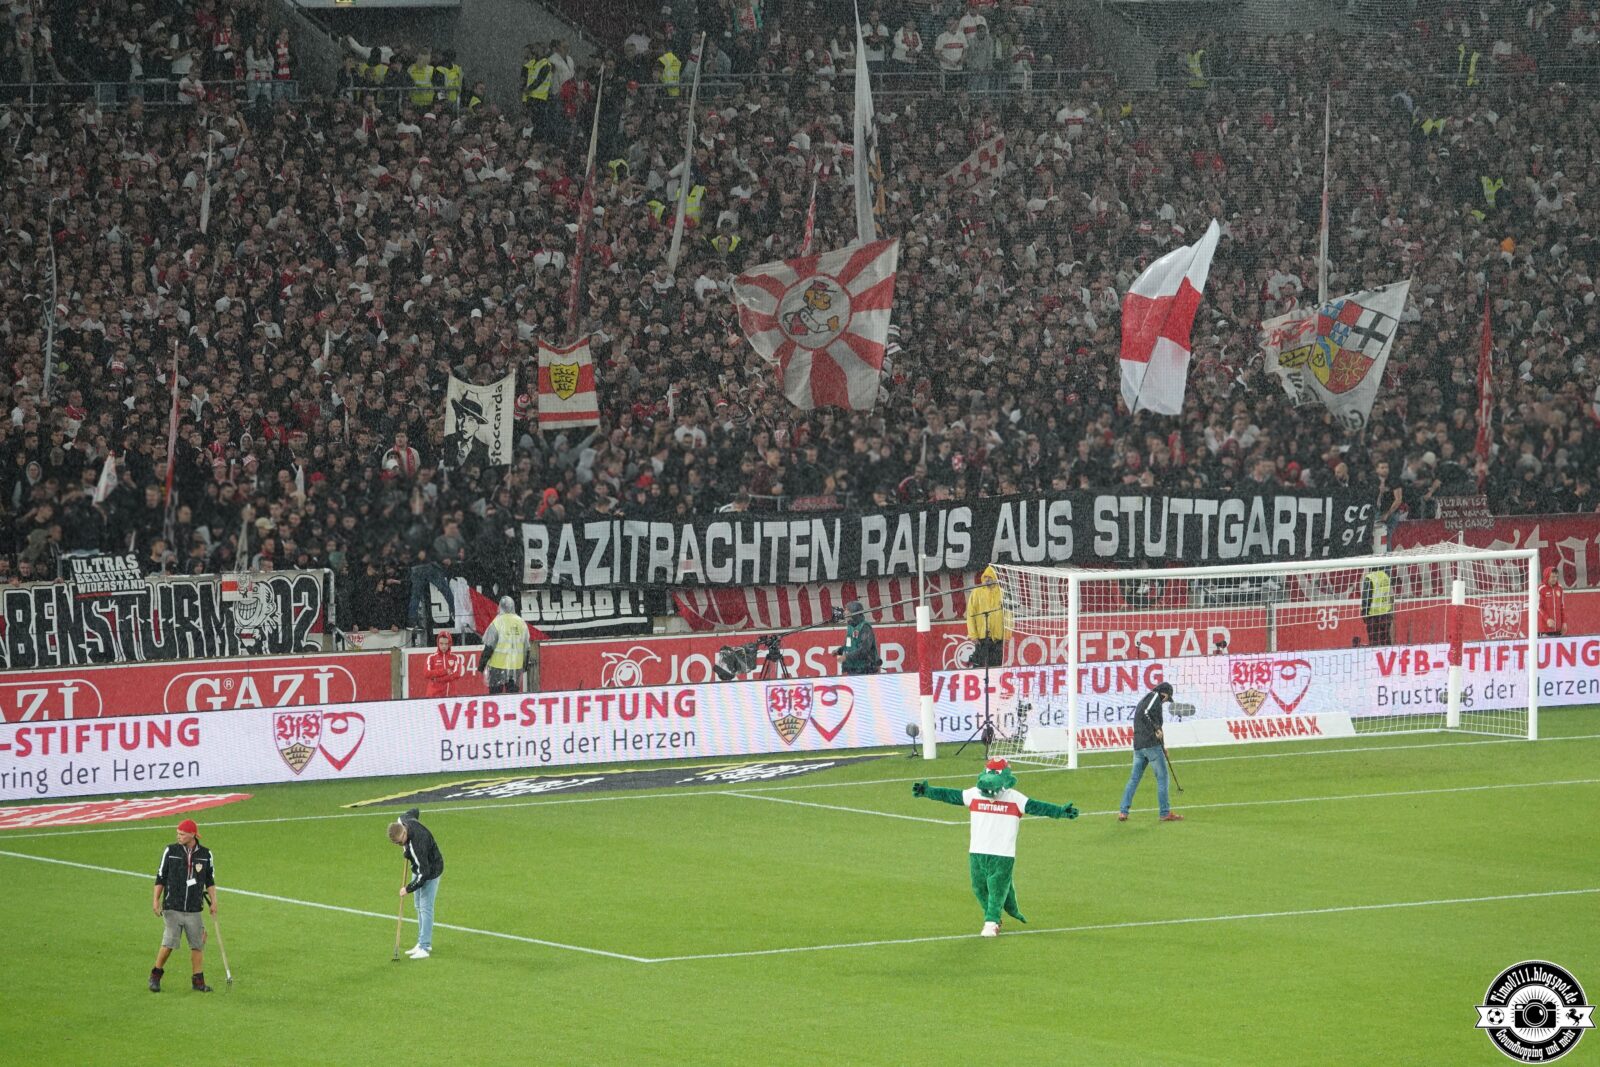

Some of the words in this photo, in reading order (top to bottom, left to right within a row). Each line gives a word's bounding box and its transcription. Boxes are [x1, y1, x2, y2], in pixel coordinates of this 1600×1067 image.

[491, 384, 504, 466] Stoccarda
[1344, 503, 1371, 523] CC
[521, 518, 841, 586] BAZITRACHTEN
[860, 506, 973, 577] RAUS
[990, 499, 1074, 564] AUS
[1094, 495, 1334, 560] STUTTGART!
[1341, 525, 1367, 546] 97
[71, 554, 139, 574] ULTRAS
[75, 569, 142, 584] BEDEUTET
[77, 579, 146, 594] WIDERSTAND
[1317, 608, 1338, 631] 35
[1376, 640, 1600, 677] VfB-TIFTUNG
[1484, 679, 1517, 700] der
[438, 689, 697, 731] VfB-STIFTUNG
[1039, 703, 1066, 726] de
[1086, 702, 1137, 723] Herz
[1226, 716, 1324, 740] WINAMAX
[441, 736, 552, 762] Brustring
[563, 732, 600, 755] der
[613, 729, 696, 752] Herzen
[61, 761, 100, 785] der
[113, 759, 200, 782] Herzen
[977, 802, 1009, 814] STUTTGART
